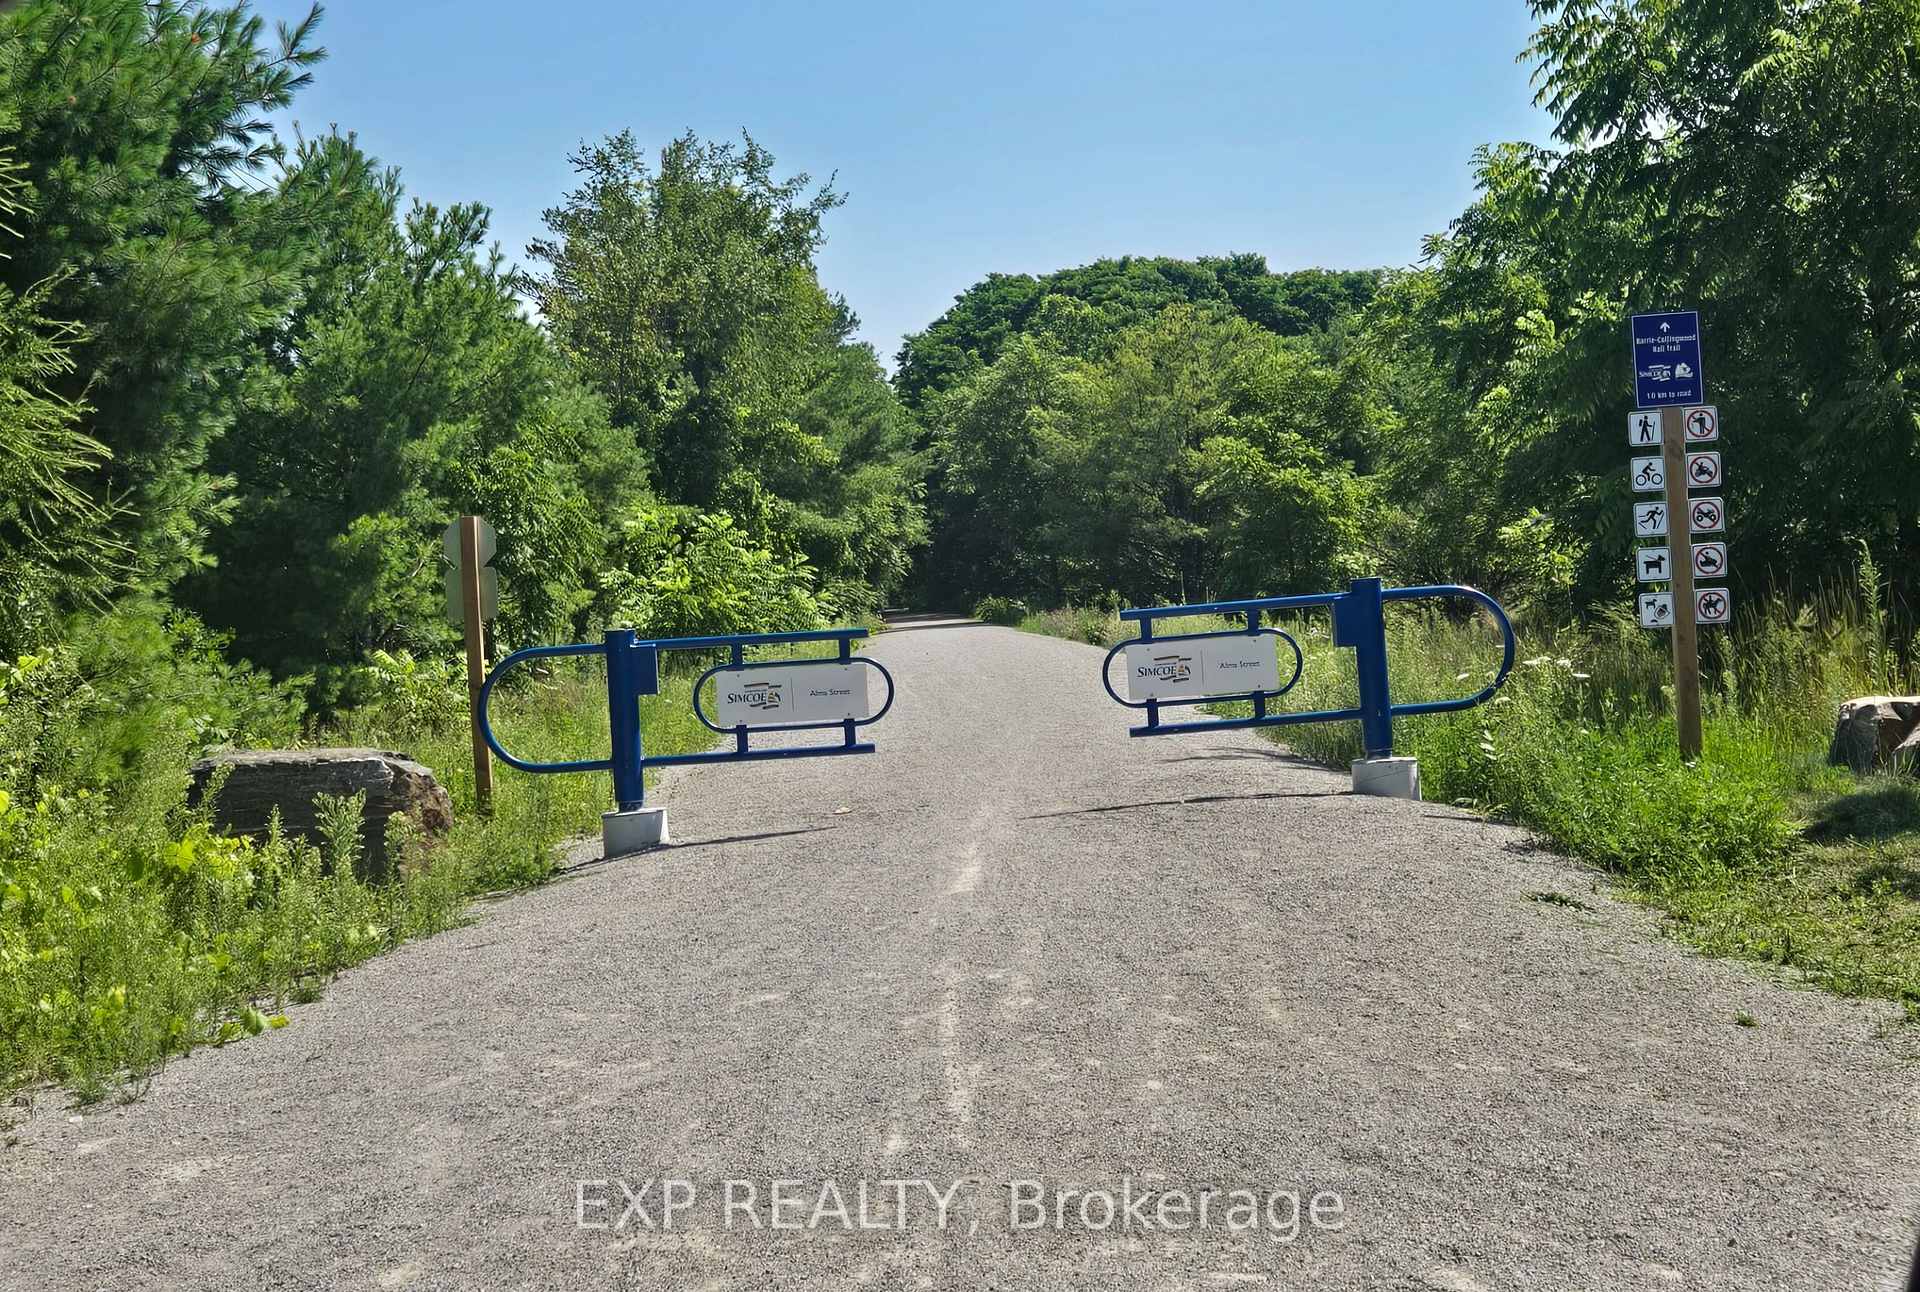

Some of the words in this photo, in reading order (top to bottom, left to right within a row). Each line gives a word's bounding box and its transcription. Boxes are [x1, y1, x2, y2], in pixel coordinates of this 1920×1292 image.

[1636, 334, 1696, 345] Barrie-Collingwood
[1658, 391, 1667, 399] km
[1239, 660, 1261, 668] Street
[1137, 666, 1177, 678] SIMCOE
[829, 688, 852, 696] Street
[727, 693, 767, 704] SIMCOE
